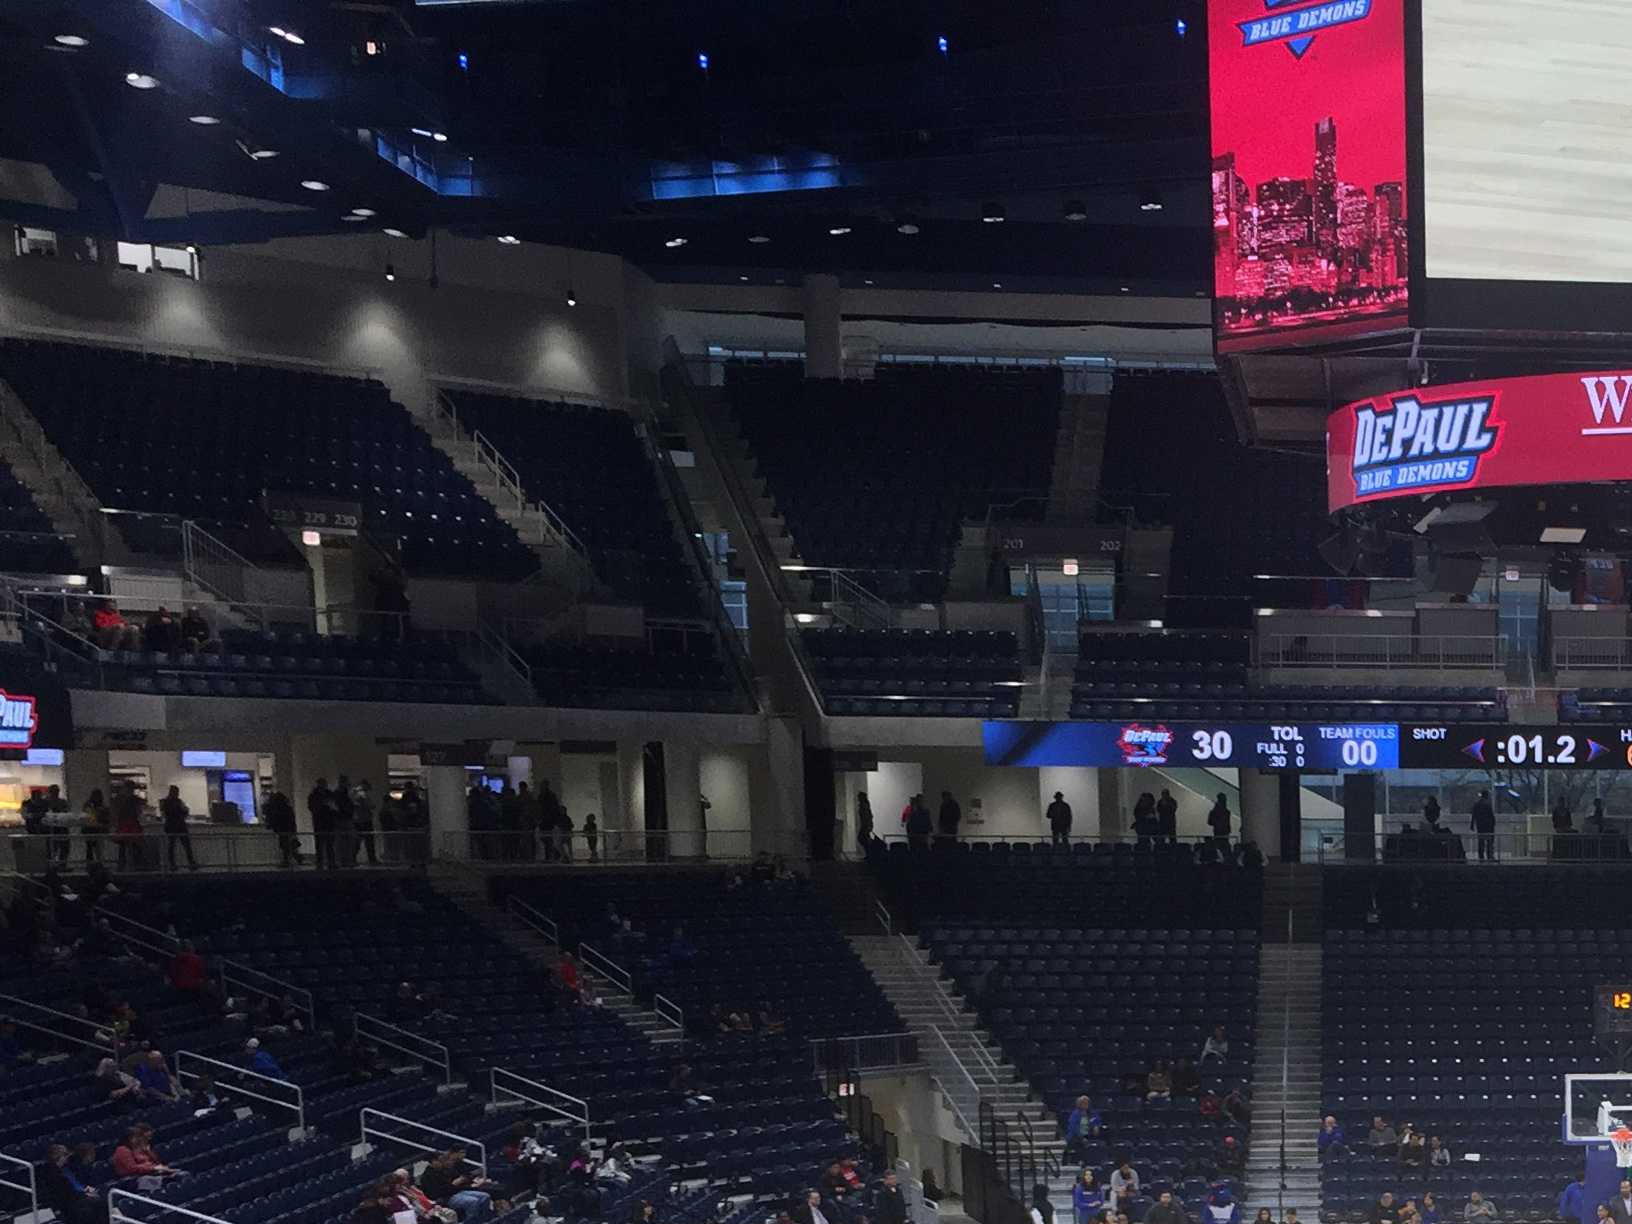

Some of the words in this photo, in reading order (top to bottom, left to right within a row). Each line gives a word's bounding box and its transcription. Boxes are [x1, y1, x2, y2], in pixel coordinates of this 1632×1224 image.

[1250, 17, 1292, 41] BLUE
[1297, 0, 1365, 29] DEMONS
[1360, 469, 1393, 491] BLUE
[1397, 460, 1470, 485] DEMONS
[1099, 540, 1121, 551] 202
[1271, 726, 1304, 741] TOL
[1319, 727, 1353, 739] TEAM
[1355, 727, 1396, 739] FOULS
[1412, 728, 1447, 740] SHOT
[1192, 730, 1232, 760] 30
[1257, 743, 1288, 755] FULL
[1295, 743, 1305, 755] 0
[1496, 734, 1576, 764] :01.2
[1342, 740, 1377, 766] 00
[1295, 756, 1305, 767] 0
